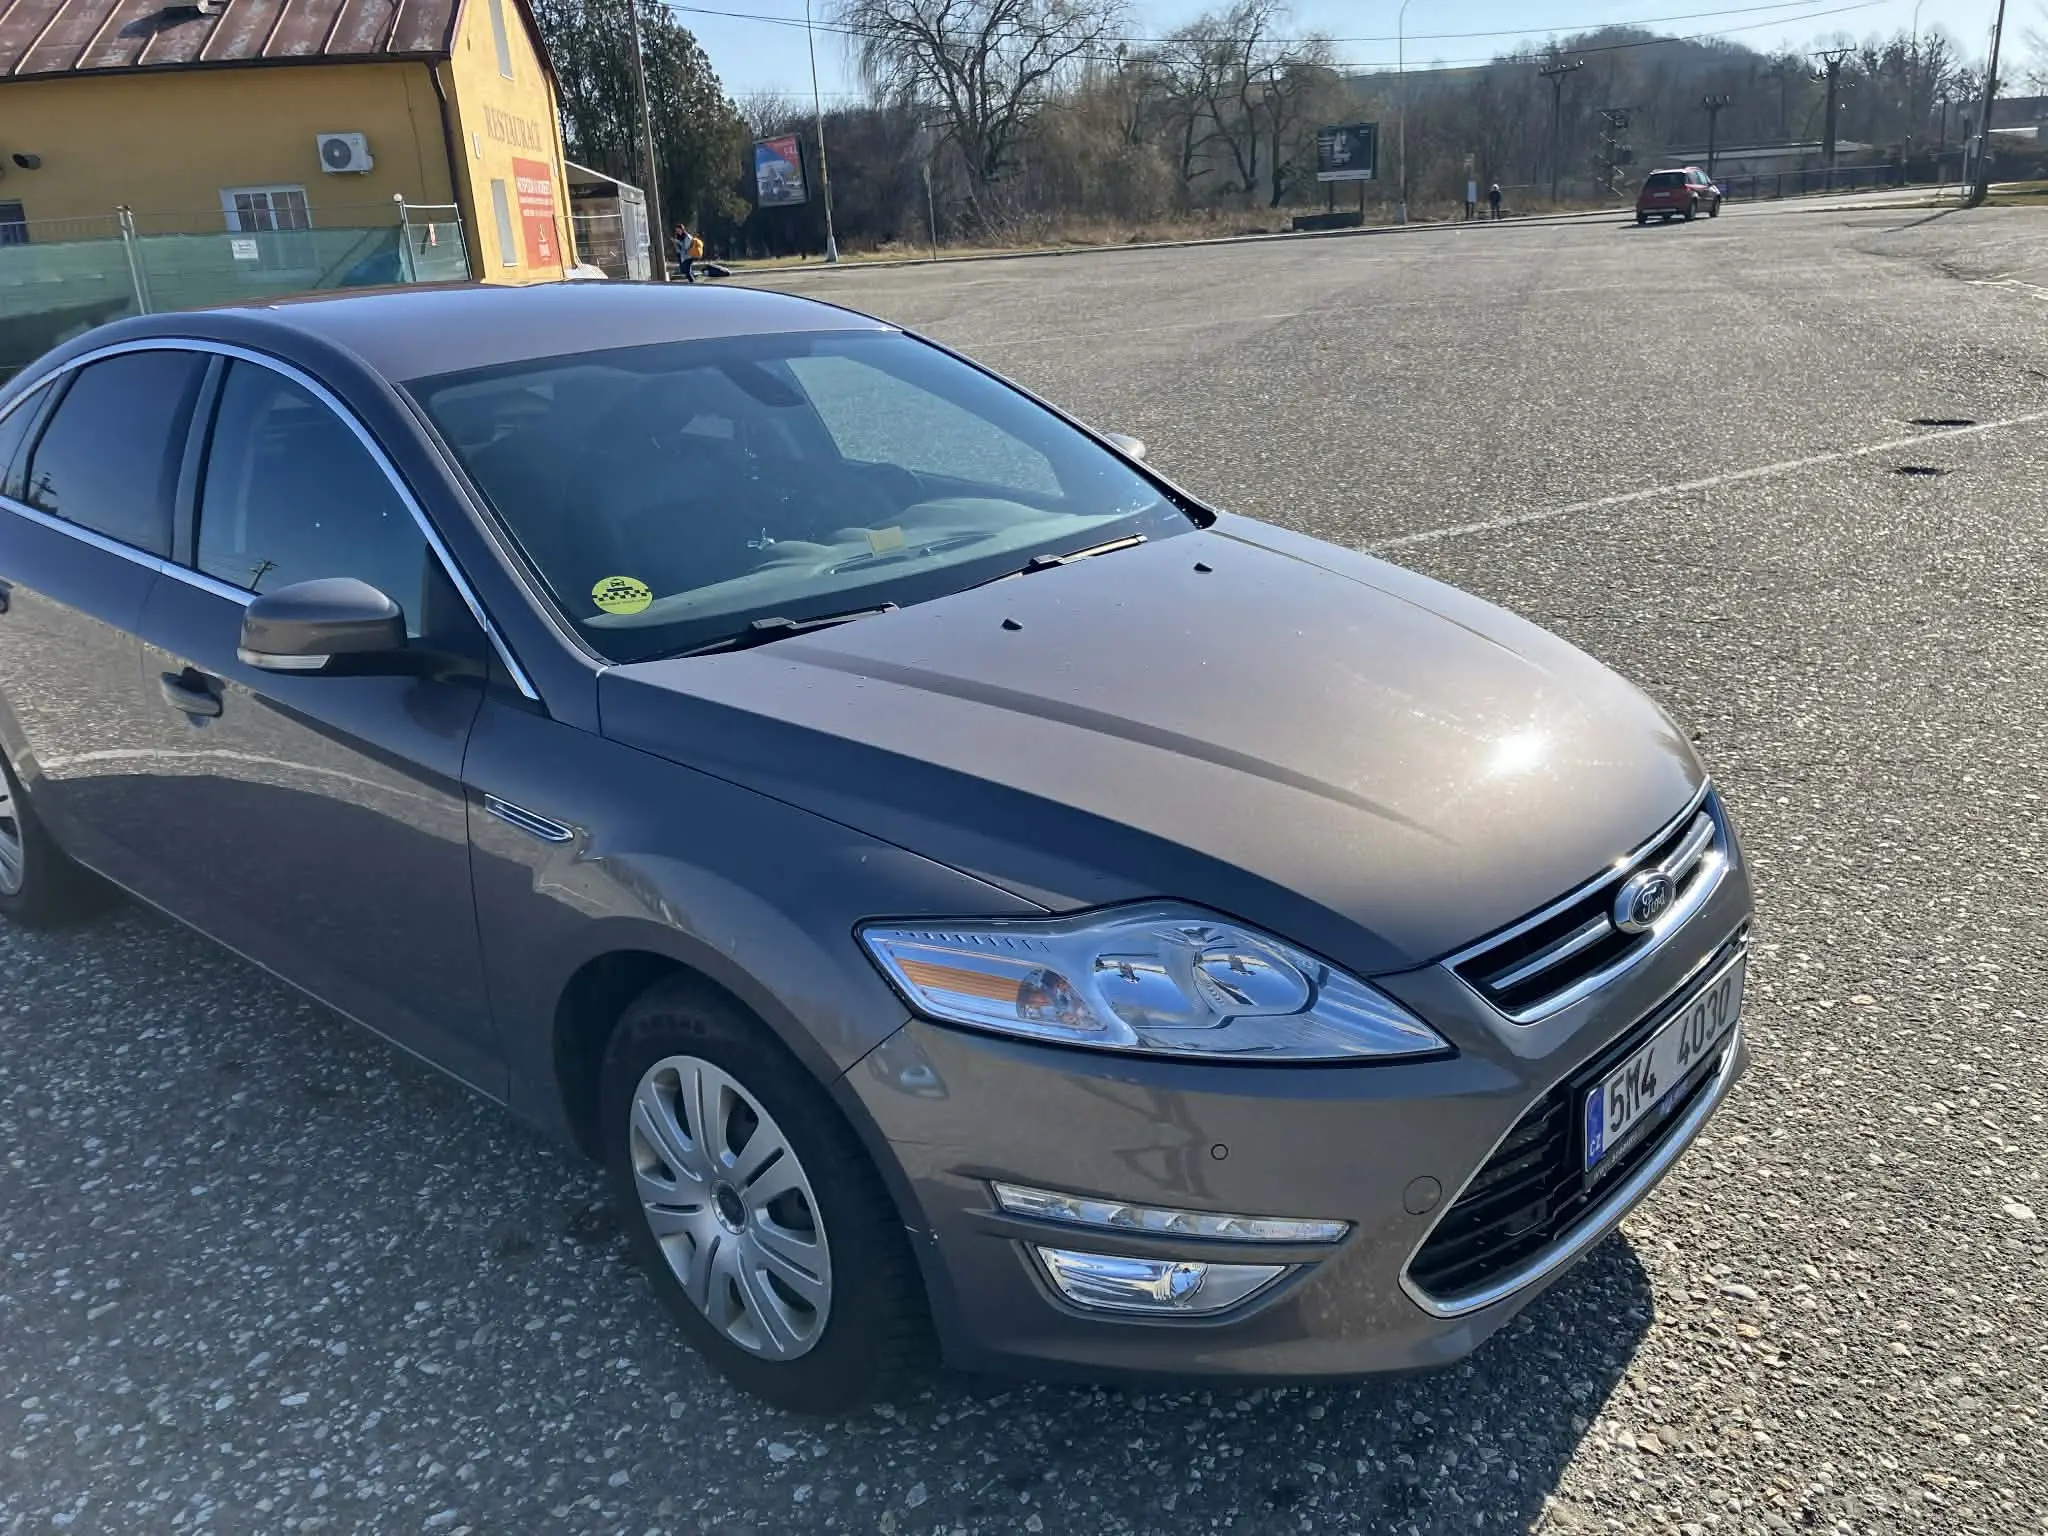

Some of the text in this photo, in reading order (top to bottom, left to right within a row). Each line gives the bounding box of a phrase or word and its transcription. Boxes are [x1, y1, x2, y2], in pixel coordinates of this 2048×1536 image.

[1642, 886, 1666, 919] Ford
[1609, 1047, 1657, 1133] 5M4
[1676, 977, 1731, 1066] 4030
